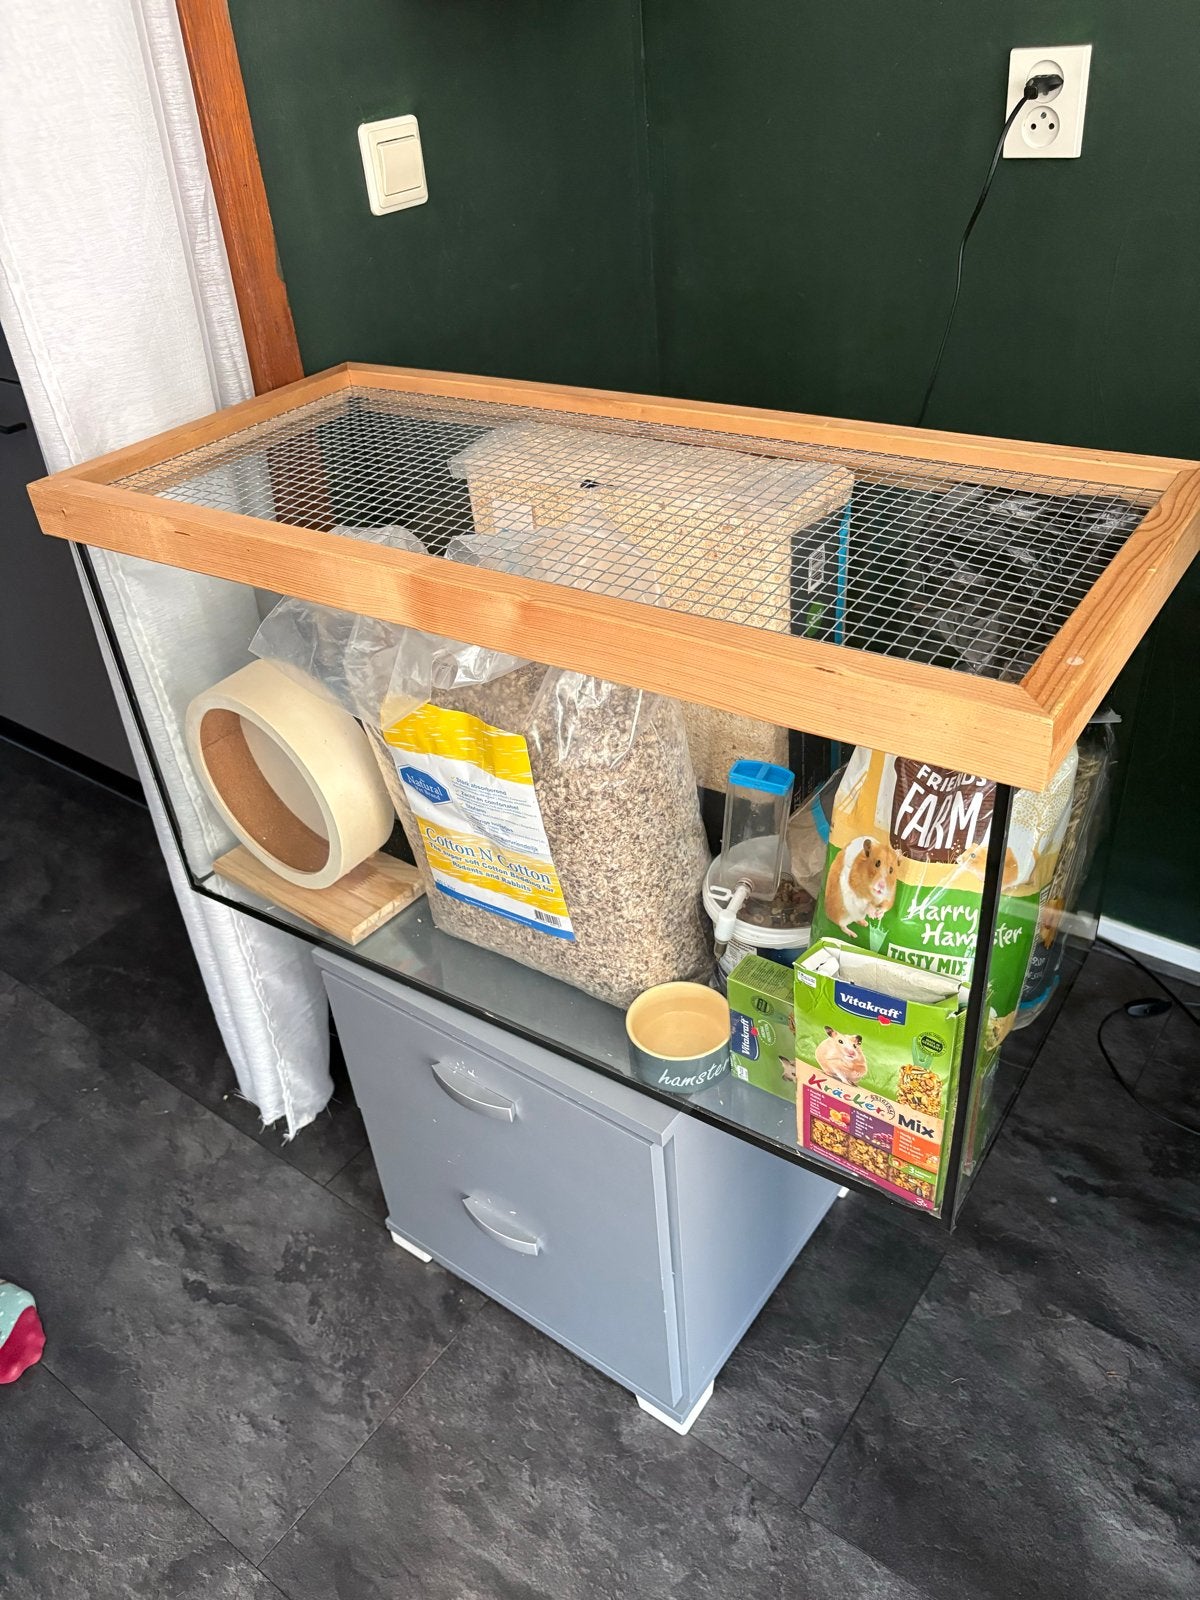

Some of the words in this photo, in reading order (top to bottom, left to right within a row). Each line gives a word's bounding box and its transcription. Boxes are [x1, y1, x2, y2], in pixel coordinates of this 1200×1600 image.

[406, 773, 443, 797] Natural
[894, 781, 984, 850] FARM
[426, 827, 475, 857] Cotton
[479, 847, 493, 862] N
[497, 855, 551, 885] Cotton
[429, 842, 441, 852] The
[443, 850, 462, 862] super
[465, 857, 480, 867] soft
[482, 861, 509, 875] Cotton
[510, 871, 541, 890] Bedding
[543, 884, 555, 893] for
[452, 861, 483, 876] Rodents
[485, 872, 500, 880] and
[502, 876, 532, 893] Rabbits
[907, 898, 978, 933] Harry
[890, 946, 932, 970] TASTY
[937, 957, 968, 976] MIX
[840, 991, 902, 1019] Vitakraft
[740, 1015, 750, 1055] Vitakraft
[658, 1057, 730, 1088] hamster
[808, 1073, 884, 1115] Kräcker
[897, 1113, 935, 1139] Mix
